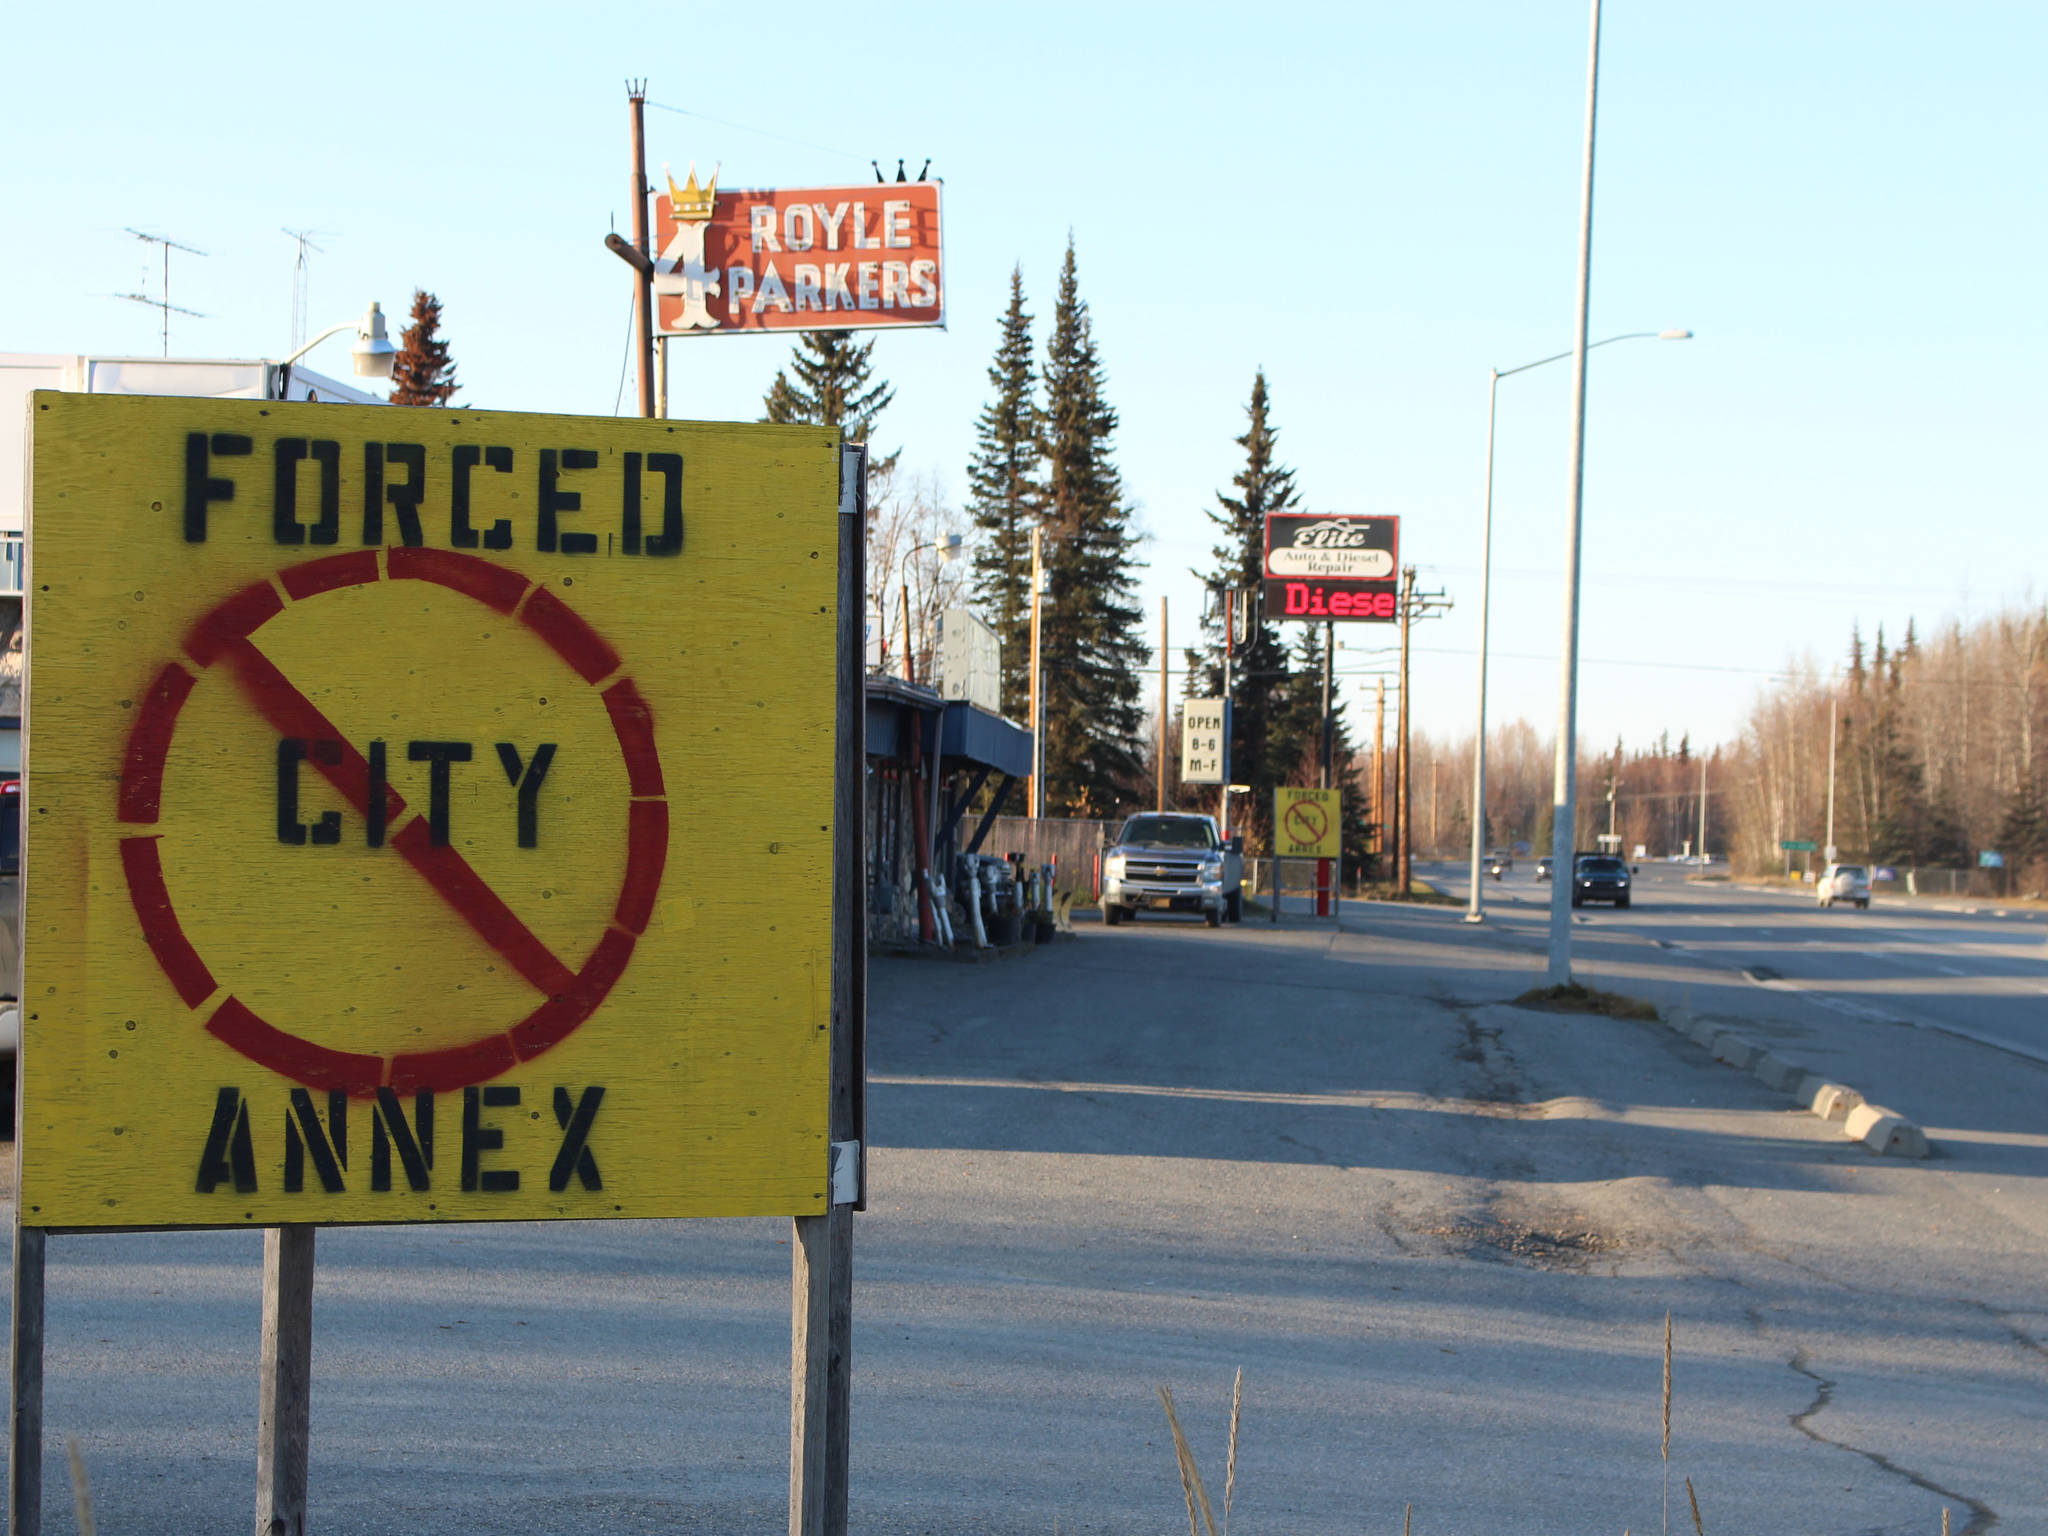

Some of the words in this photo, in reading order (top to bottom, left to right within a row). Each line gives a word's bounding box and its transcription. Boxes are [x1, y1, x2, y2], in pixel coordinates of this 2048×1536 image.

[750, 200, 912, 253] ROYLE
[654, 221, 721, 330] 4
[728, 259, 937, 314] PARKERS
[184, 432, 684, 557] FORCED
[1284, 551, 1316, 561] Auto
[1321, 552, 1330, 561] &
[1337, 552, 1379, 562] Diesel
[1293, 529, 1365, 548] Elite
[1308, 562, 1353, 575] Repair
[1285, 582, 1396, 617] Diese
[1188, 716, 1220, 729] OPEN
[276, 738, 558, 849] CITY
[194, 1085, 606, 1194] ANNEX
